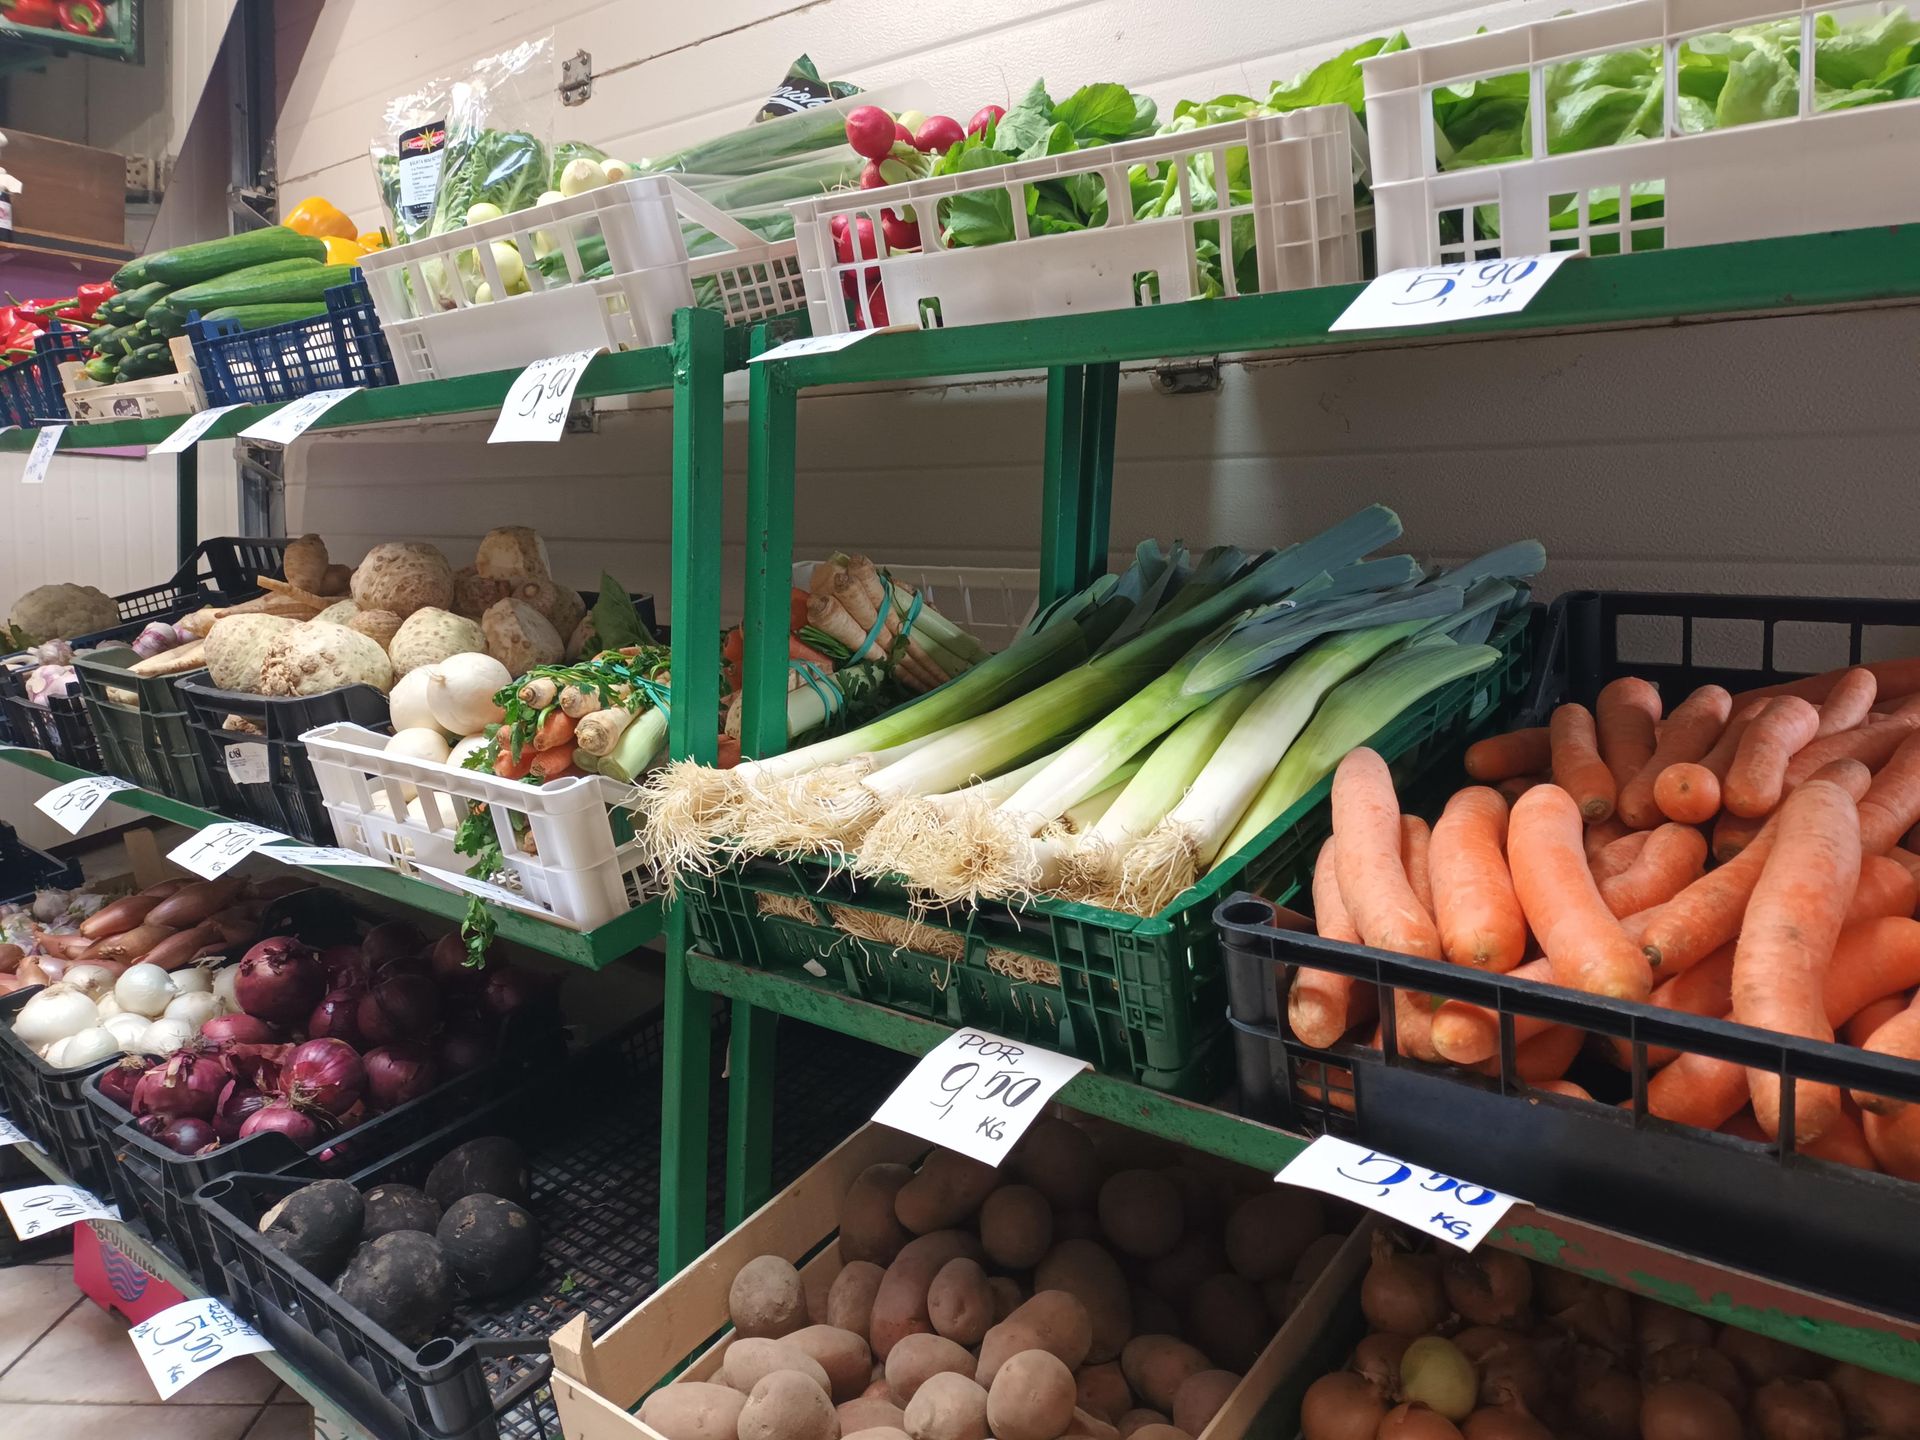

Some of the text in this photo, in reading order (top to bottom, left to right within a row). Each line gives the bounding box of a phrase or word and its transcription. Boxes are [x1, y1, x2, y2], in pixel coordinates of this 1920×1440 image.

[1392, 260, 1539, 307] 5,90
[958, 1033, 1025, 1066] POR
[929, 1062, 1042, 1121] 9,50
[975, 1115, 1007, 1142] KG
[1430, 1211, 1473, 1240] KG
[166, 1363, 186, 1385] KG
